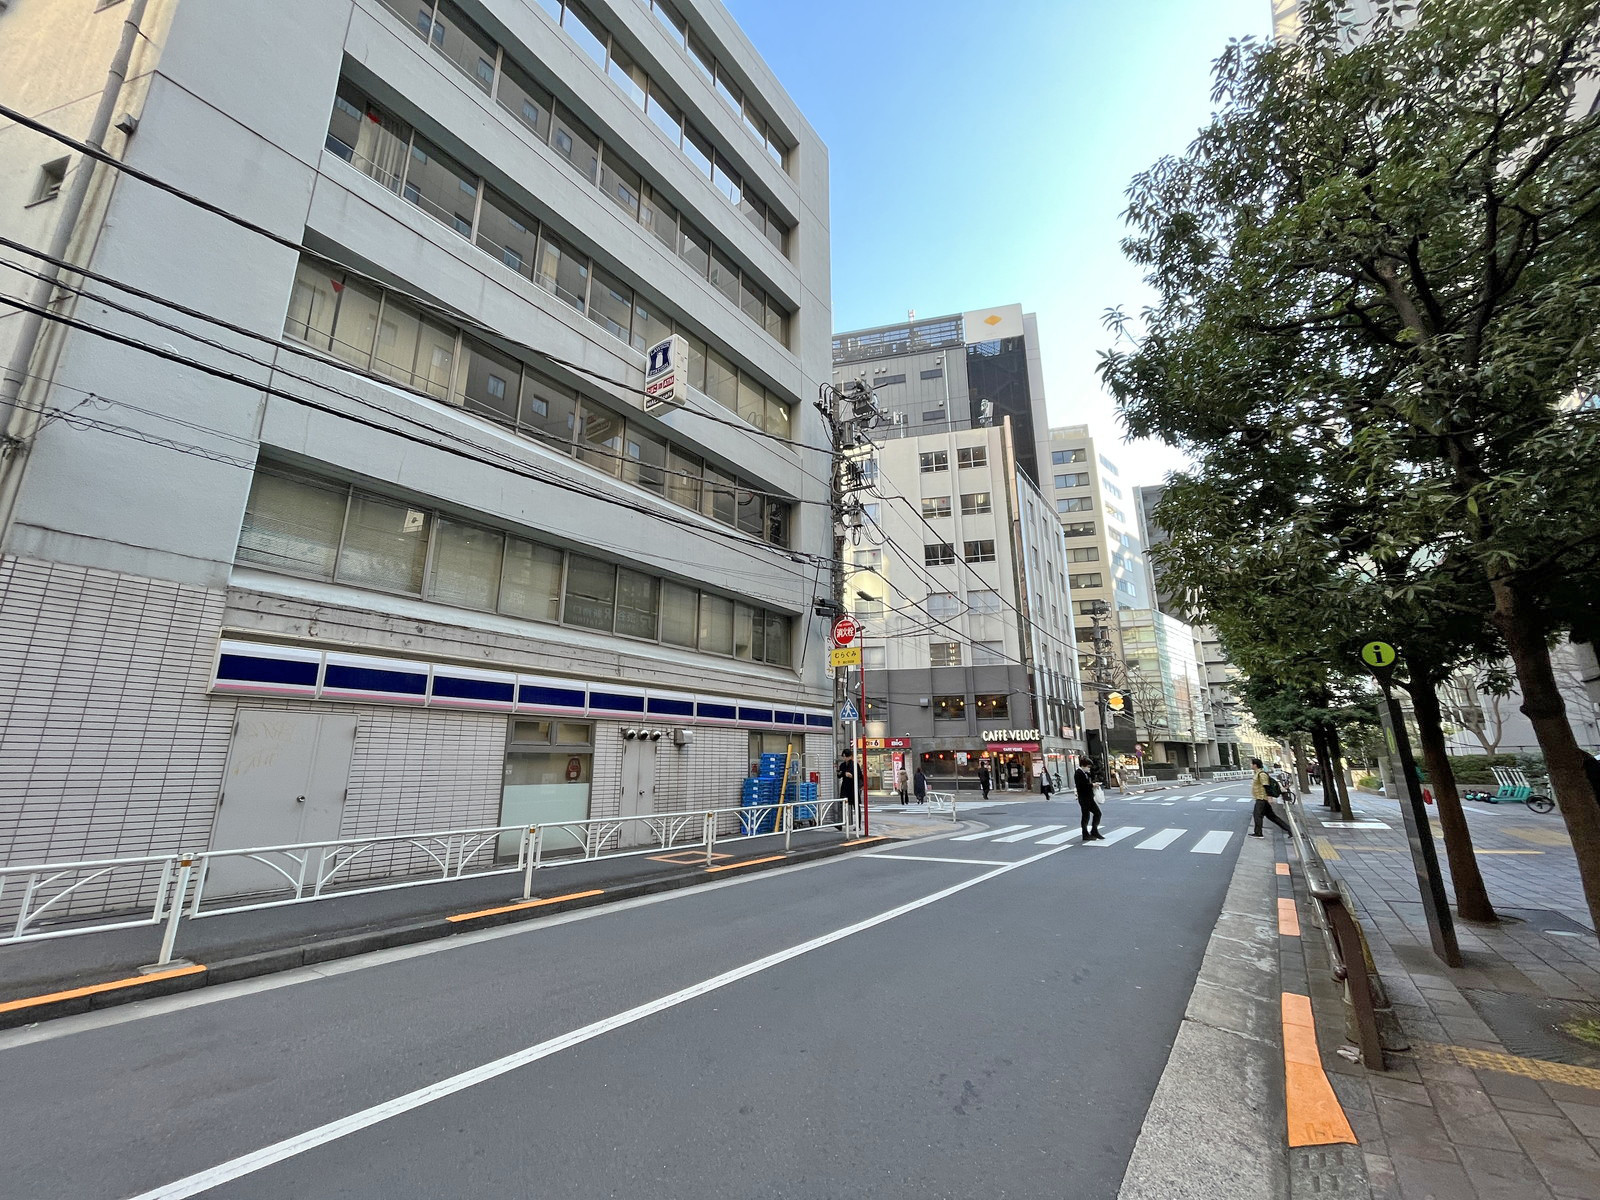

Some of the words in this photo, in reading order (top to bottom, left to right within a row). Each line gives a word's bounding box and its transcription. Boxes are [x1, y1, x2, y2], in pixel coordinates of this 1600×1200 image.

[836, 627, 854, 638] 消火栓
[1009, 729, 1040, 741] VELOCE
